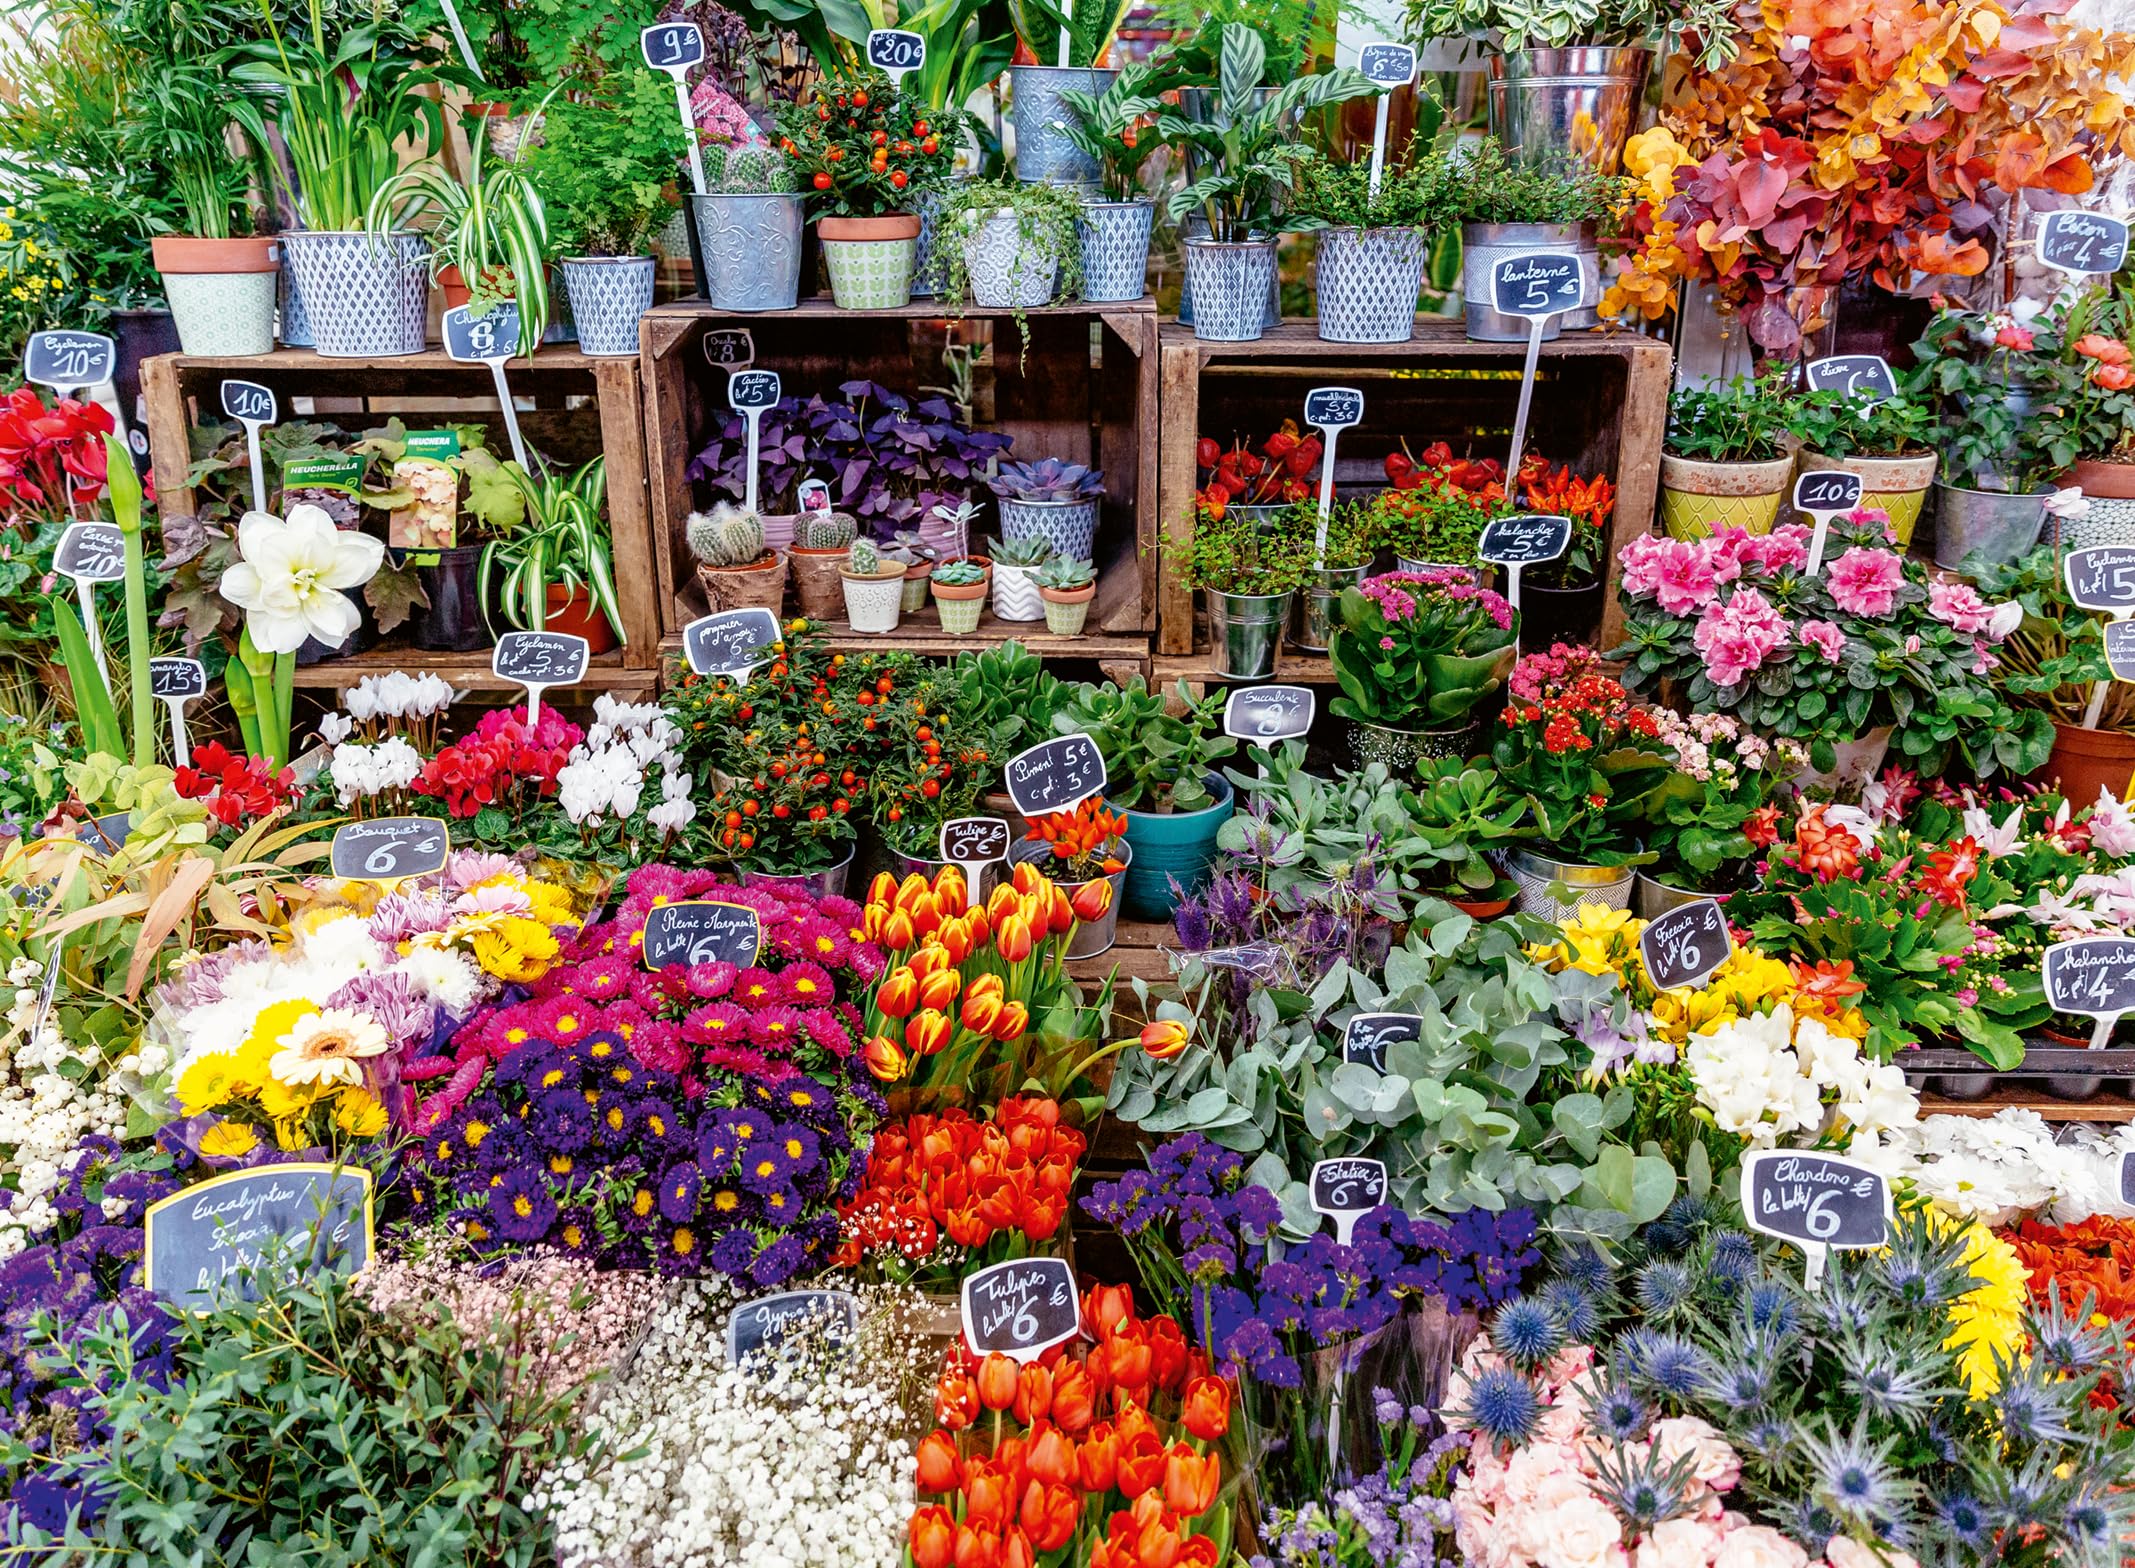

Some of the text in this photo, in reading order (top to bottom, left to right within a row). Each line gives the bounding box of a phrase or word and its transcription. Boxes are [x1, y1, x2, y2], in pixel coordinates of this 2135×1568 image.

[2074, 237, 2122, 268] 4 €
[1501, 260, 1570, 283] lanterne
[1519, 278, 1579, 309] 5 €
[468, 321, 495, 350] 8
[720, 344, 735, 363] 8
[1866, 366, 1878, 378] €
[748, 385, 763, 403] 5
[515, 635, 566, 656] Cyclamen
[730, 637, 743, 655] 6
[529, 650, 552, 667] 5
[568, 649, 582, 660] €
[1257, 703, 1284, 735] 8
[344, 821, 421, 841] Bouquet
[947, 822, 988, 840] Tulipe
[365, 836, 441, 873] 6 €
[952, 837, 978, 859] 6
[1703, 907, 1718, 931] €
[735, 935, 755, 951] €
[1680, 929, 1701, 970] 6
[2088, 966, 2115, 1008] 4
[1331, 1181, 1359, 1206] 6
[1849, 1176, 1875, 1197] €
[1805, 1189, 1843, 1238] 6
[332, 1219, 350, 1243] €
[1011, 1295, 1039, 1342] 6
[1048, 1282, 1069, 1306] €
